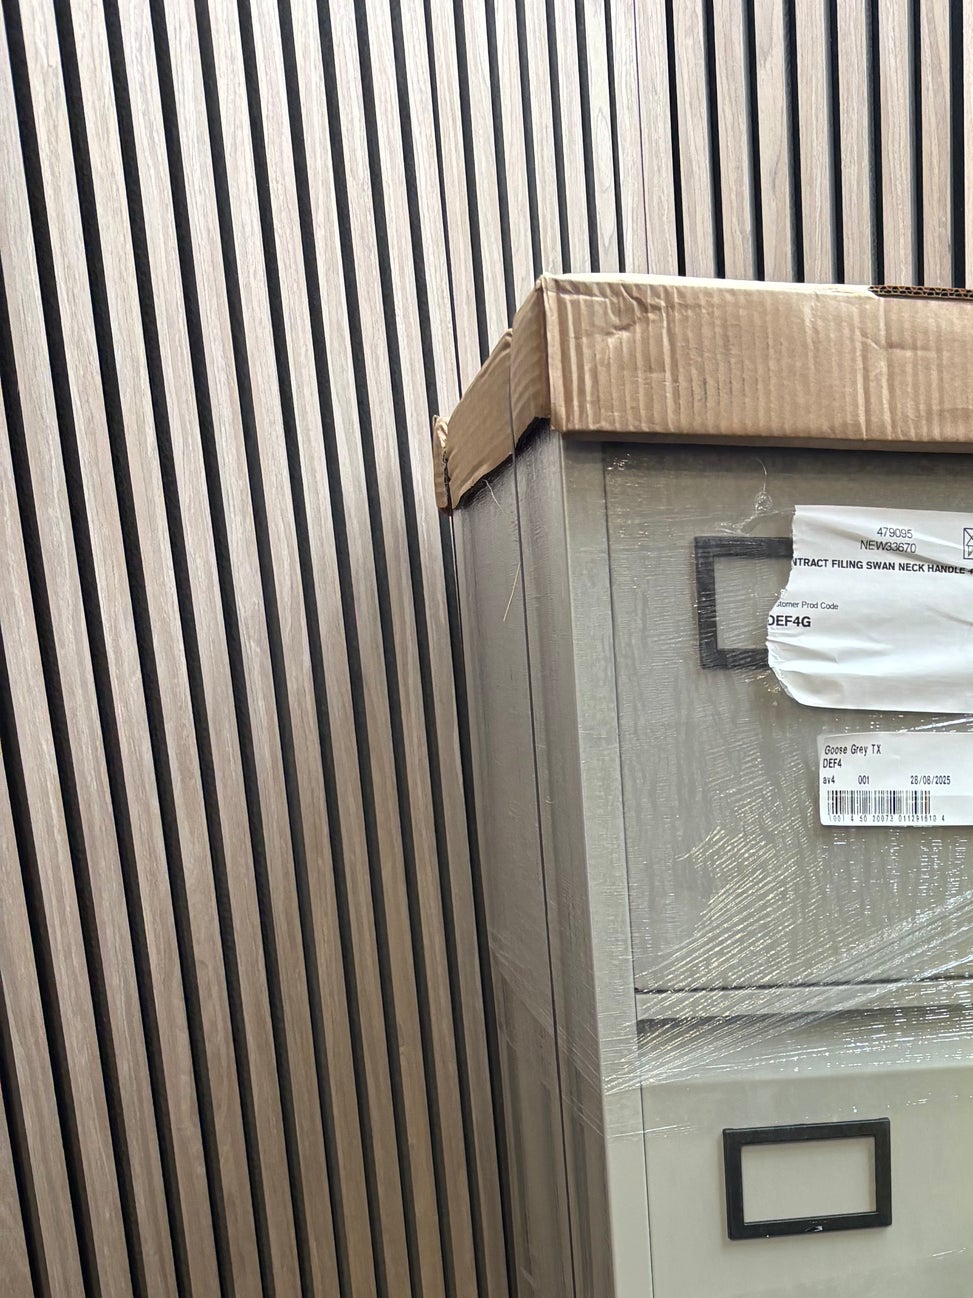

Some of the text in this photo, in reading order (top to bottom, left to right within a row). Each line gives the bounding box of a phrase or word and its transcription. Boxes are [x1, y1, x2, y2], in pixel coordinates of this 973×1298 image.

[876, 527, 913, 539] 479095
[860, 539, 917, 554] NEW33670
[831, 559, 864, 570] FILING
[866, 561, 896, 571] SWAN
[898, 562, 926, 573] NECK
[927, 564, 966, 575] HANDLE
[801, 600, 819, 610] Prod
[820, 601, 839, 611] Code
[824, 743, 882, 757] Goose Grey TX
[822, 758, 842, 769] DEF4
[822, 774, 952, 786] av4 001 28/08/2025
[872, 814, 894, 823] 20073
